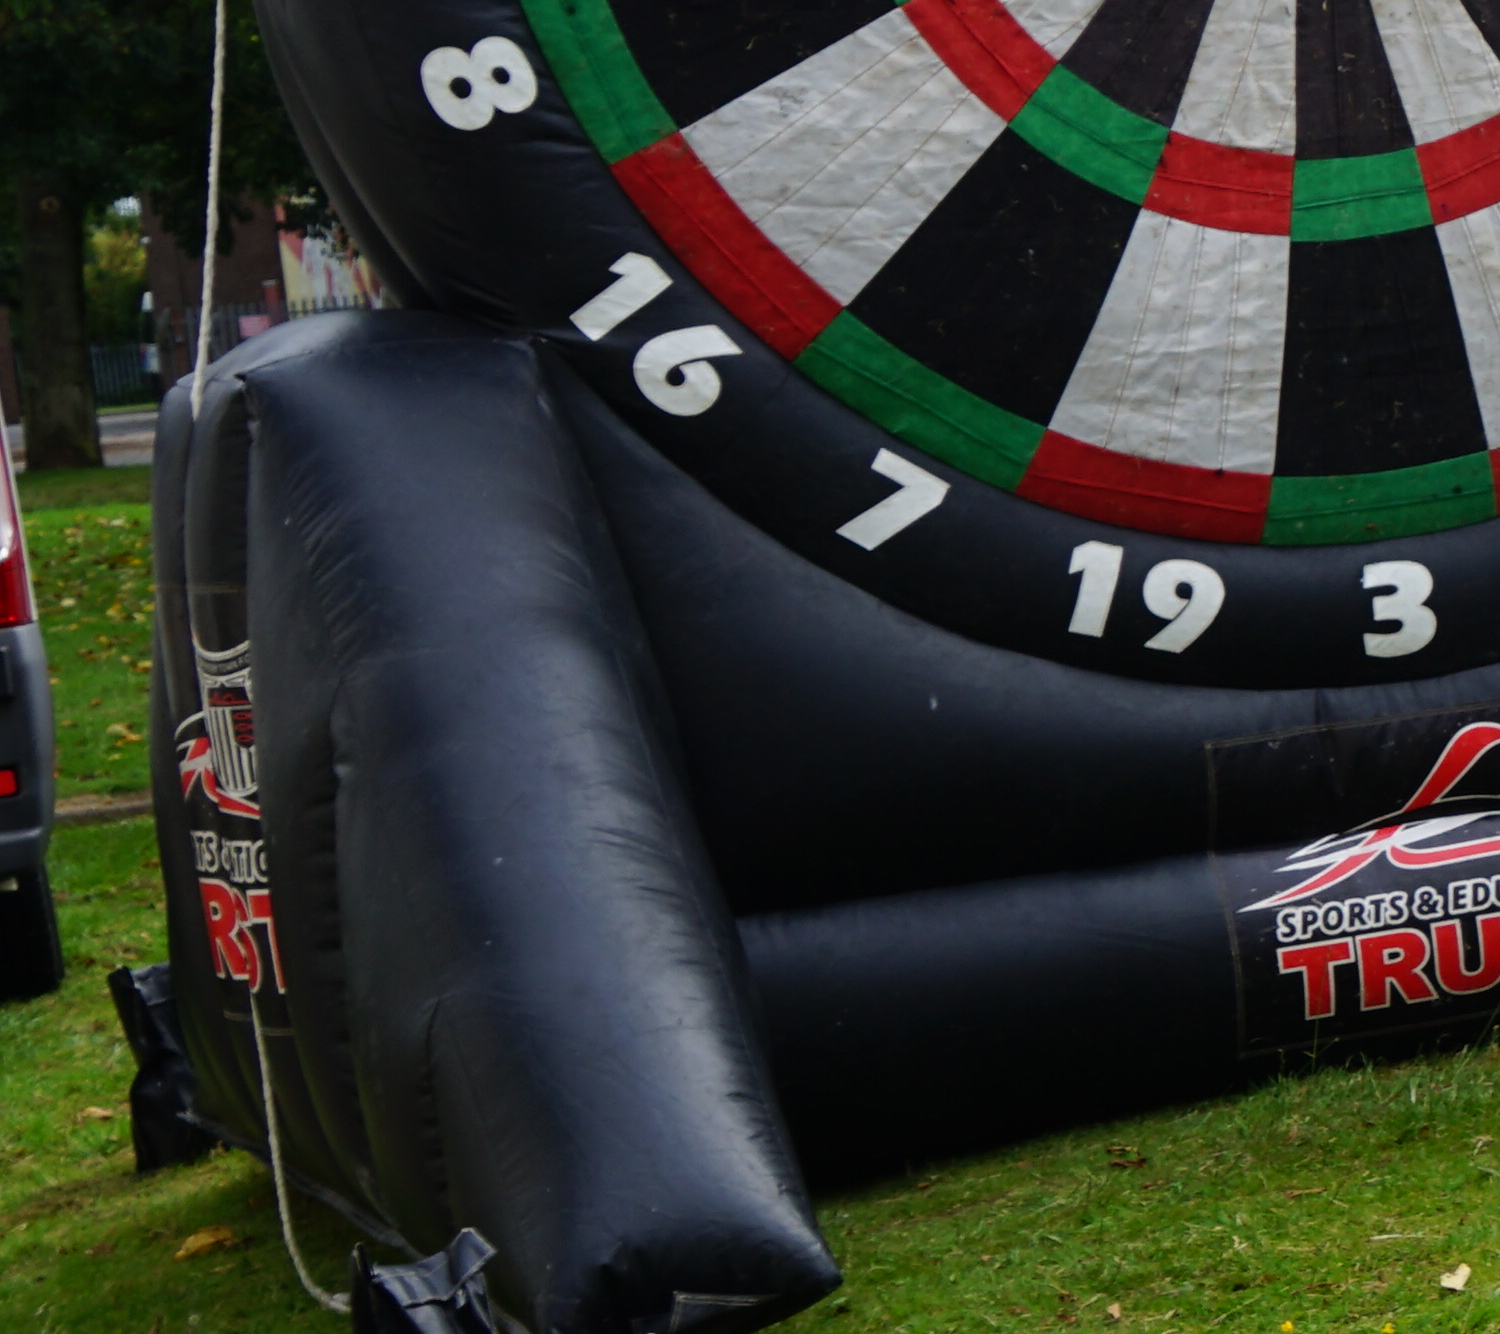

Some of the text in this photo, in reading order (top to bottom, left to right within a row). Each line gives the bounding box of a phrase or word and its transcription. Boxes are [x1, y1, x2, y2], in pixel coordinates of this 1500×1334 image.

[421, 37, 537, 130] 8
[570, 253, 742, 415] 16
[837, 448, 950, 550] 7
[1069, 541, 1225, 652] 19
[1361, 561, 1436, 656] 3
[1276, 891, 1404, 943] SPORTS
[1412, 886, 1445, 919] &
